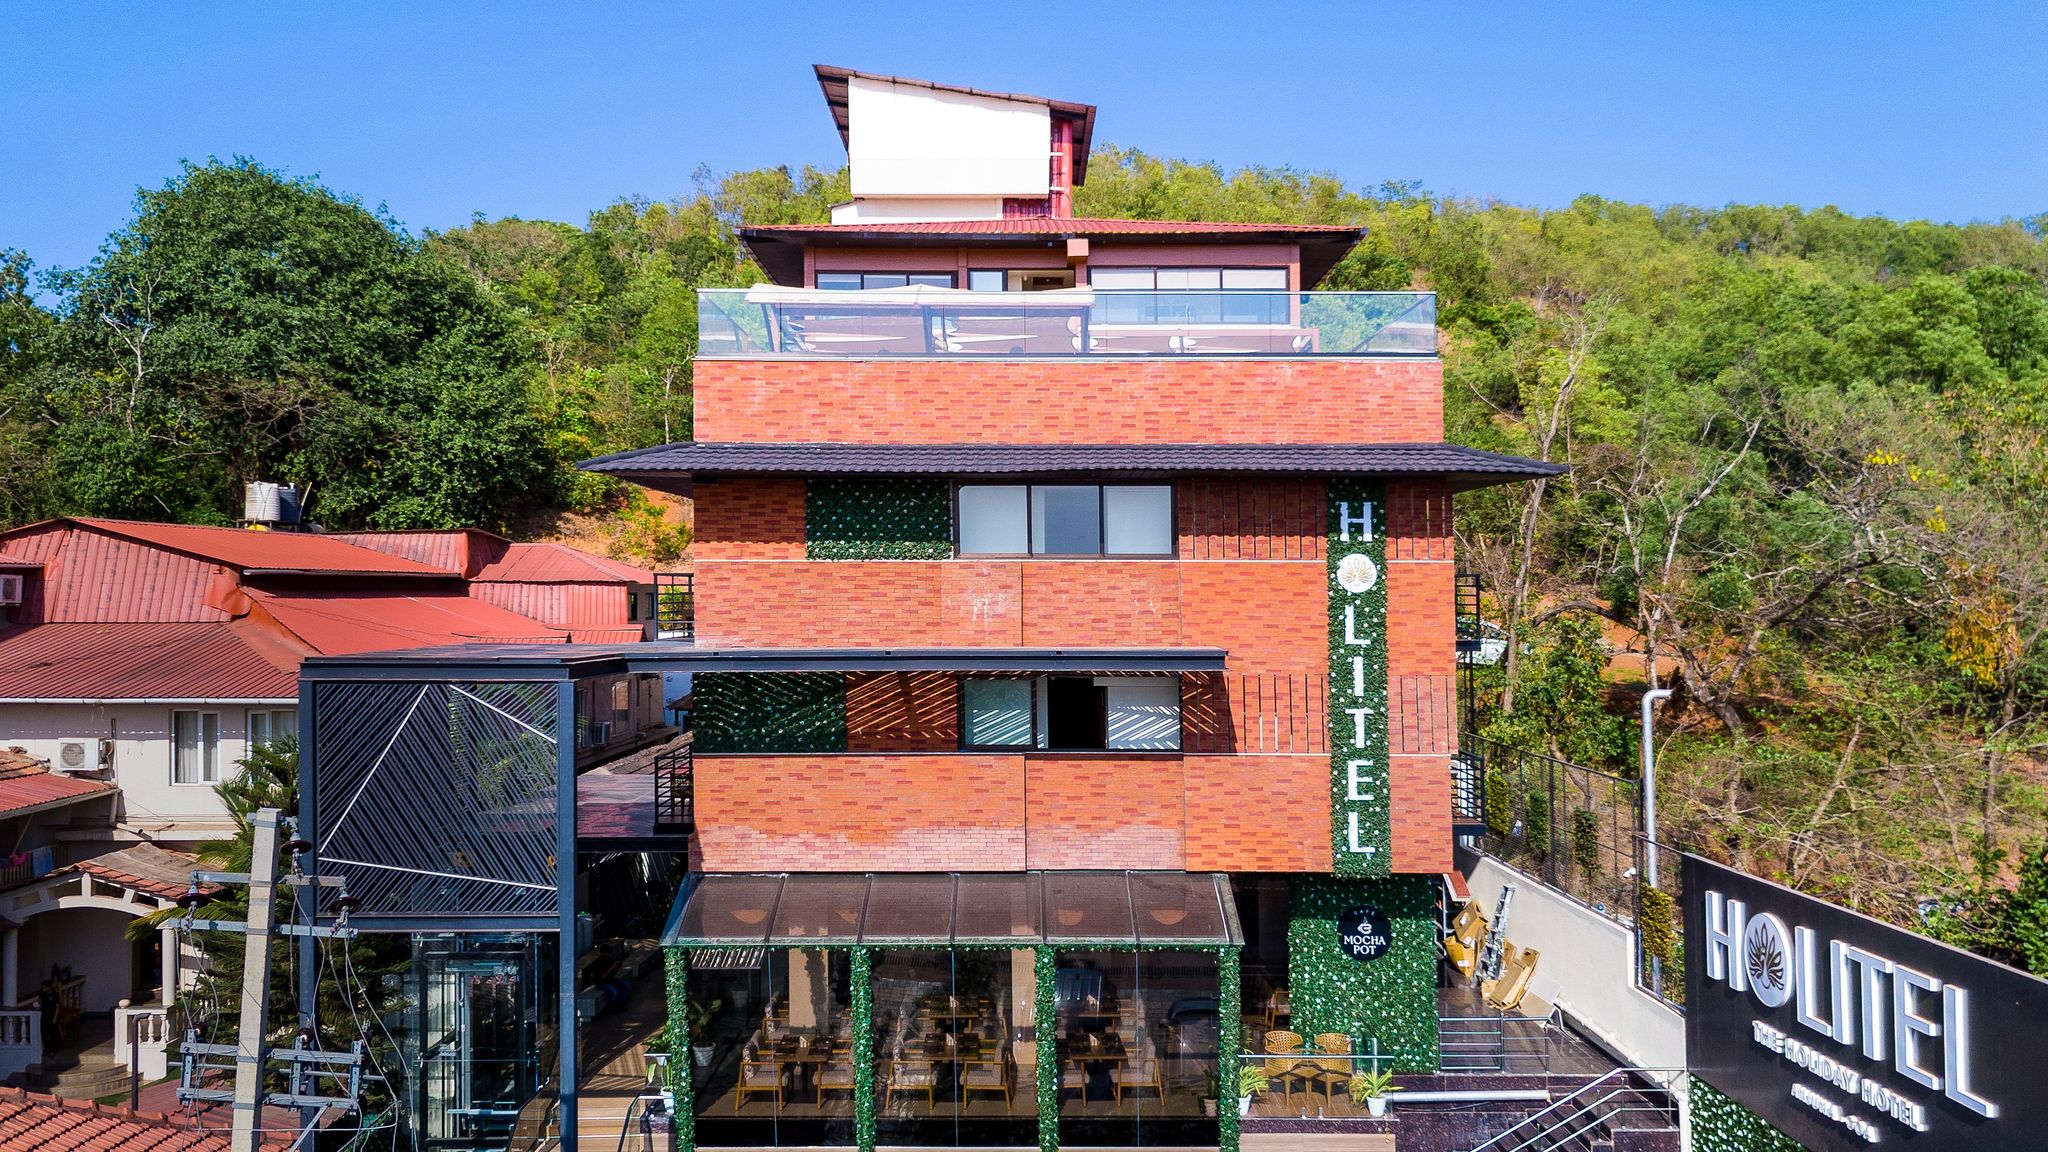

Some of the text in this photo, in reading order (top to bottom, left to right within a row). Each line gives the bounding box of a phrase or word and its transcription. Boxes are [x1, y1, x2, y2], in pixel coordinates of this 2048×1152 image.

[1343, 935, 1387, 946] MOCHA
[1353, 945, 1377, 955] POT
[1705, 890, 1999, 1118] HOLITEL
[1752, 1020, 1929, 1132] THE HOLIDAY HOTEL
